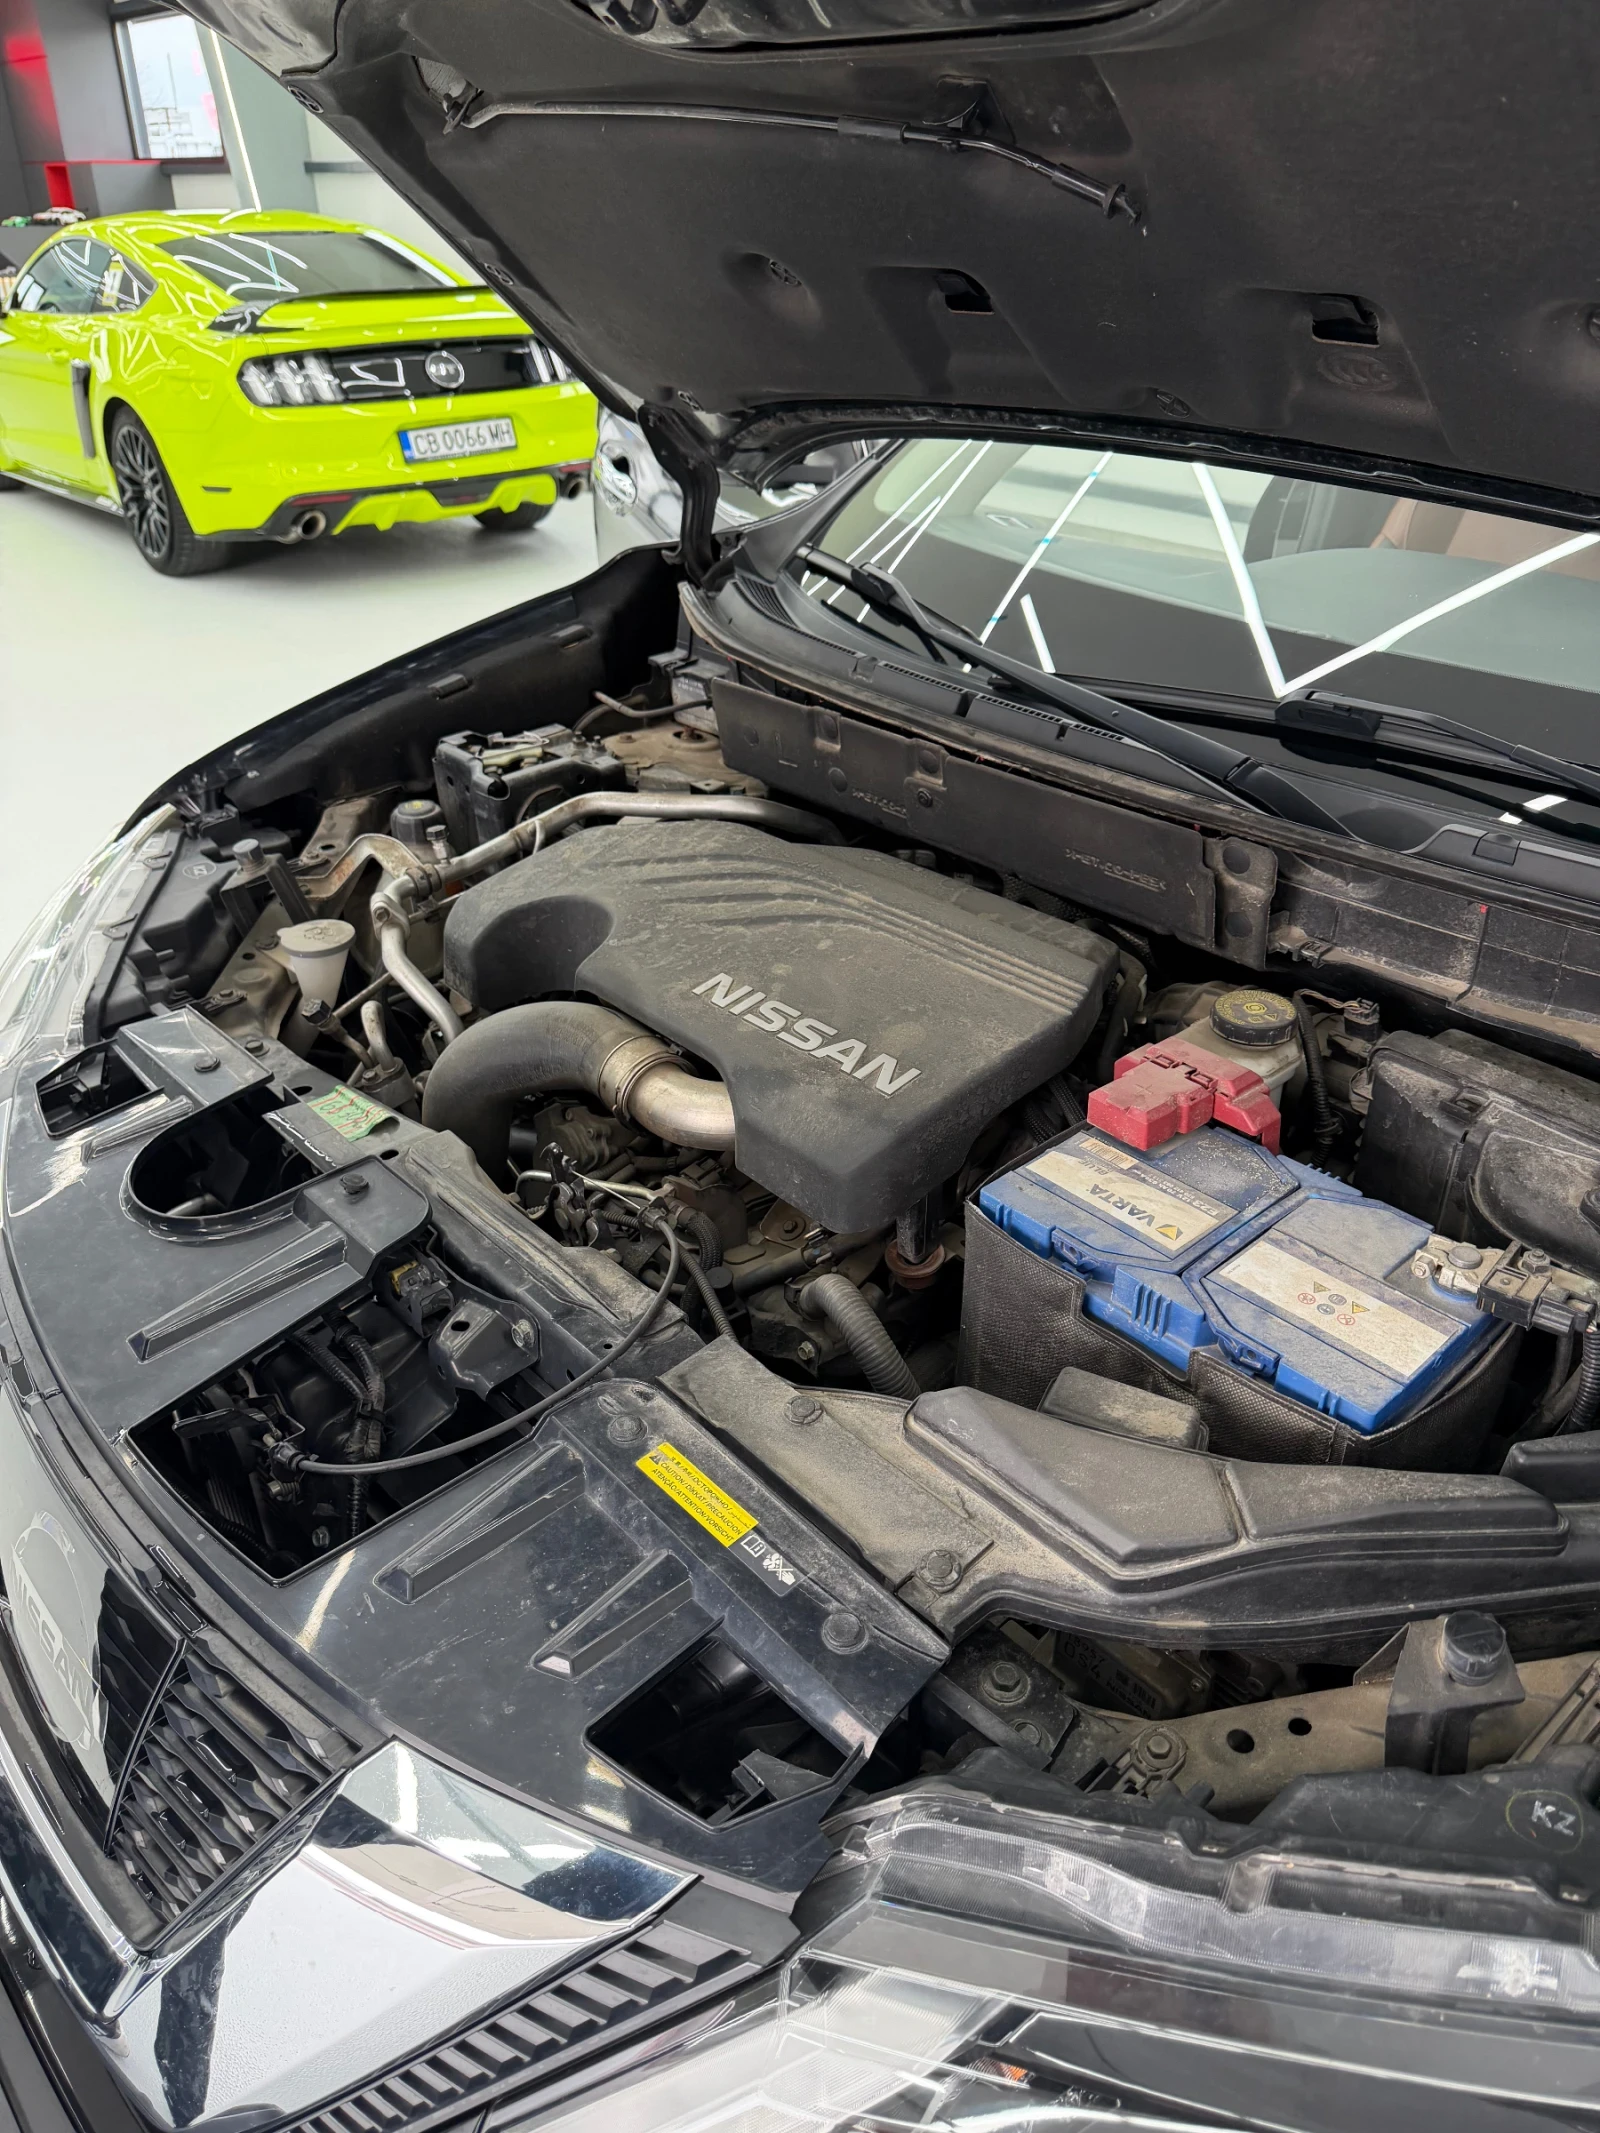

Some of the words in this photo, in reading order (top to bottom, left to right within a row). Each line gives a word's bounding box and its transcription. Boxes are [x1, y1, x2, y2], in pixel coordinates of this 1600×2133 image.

[414, 433, 440, 456] CB
[442, 427, 487, 451] 0066
[691, 972, 921, 1097] NISSAN
[1087, 1183, 1157, 1227] VARTA
[1191, 1199, 1220, 1217] E23
